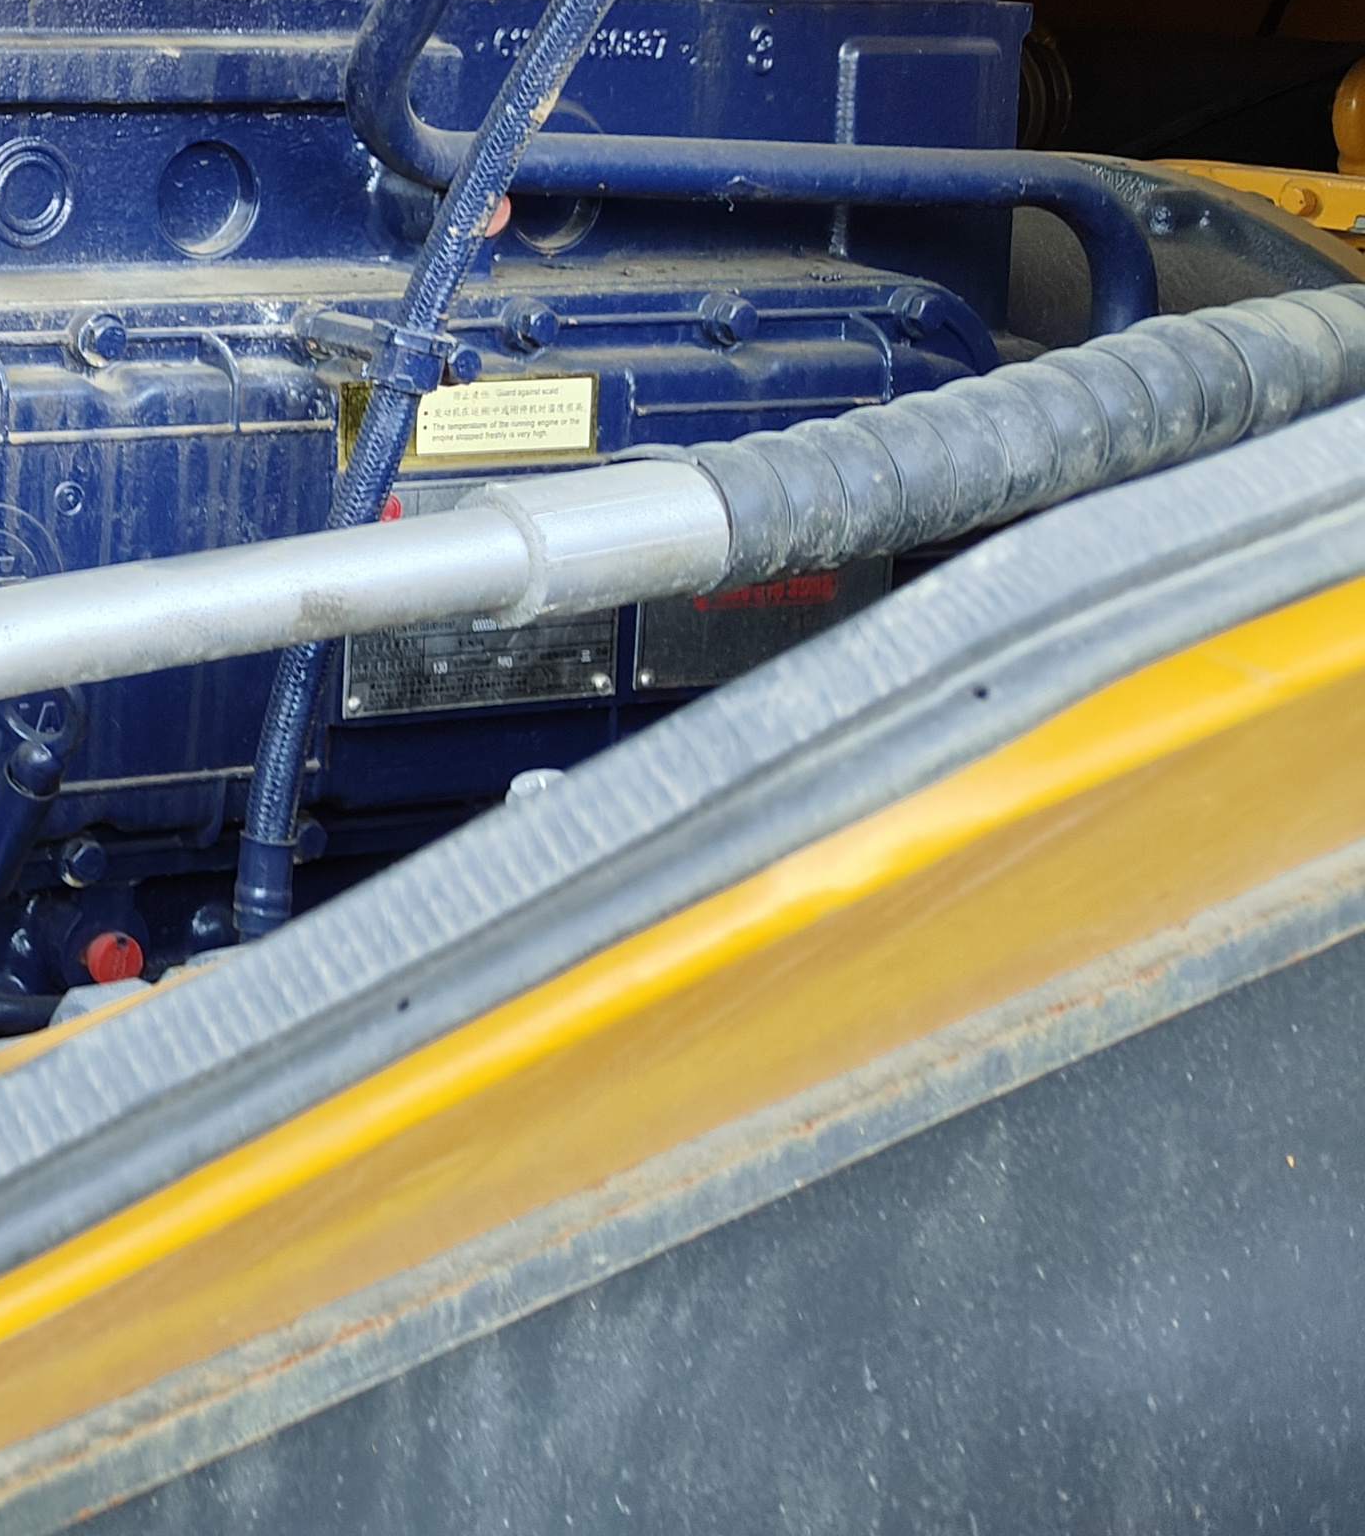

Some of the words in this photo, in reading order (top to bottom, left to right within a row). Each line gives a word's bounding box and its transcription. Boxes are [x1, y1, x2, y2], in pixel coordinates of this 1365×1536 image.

[510, 420, 535, 429] running
[536, 419, 559, 428] engine
[431, 434, 454, 442] engine
[516, 431, 531, 439] very
